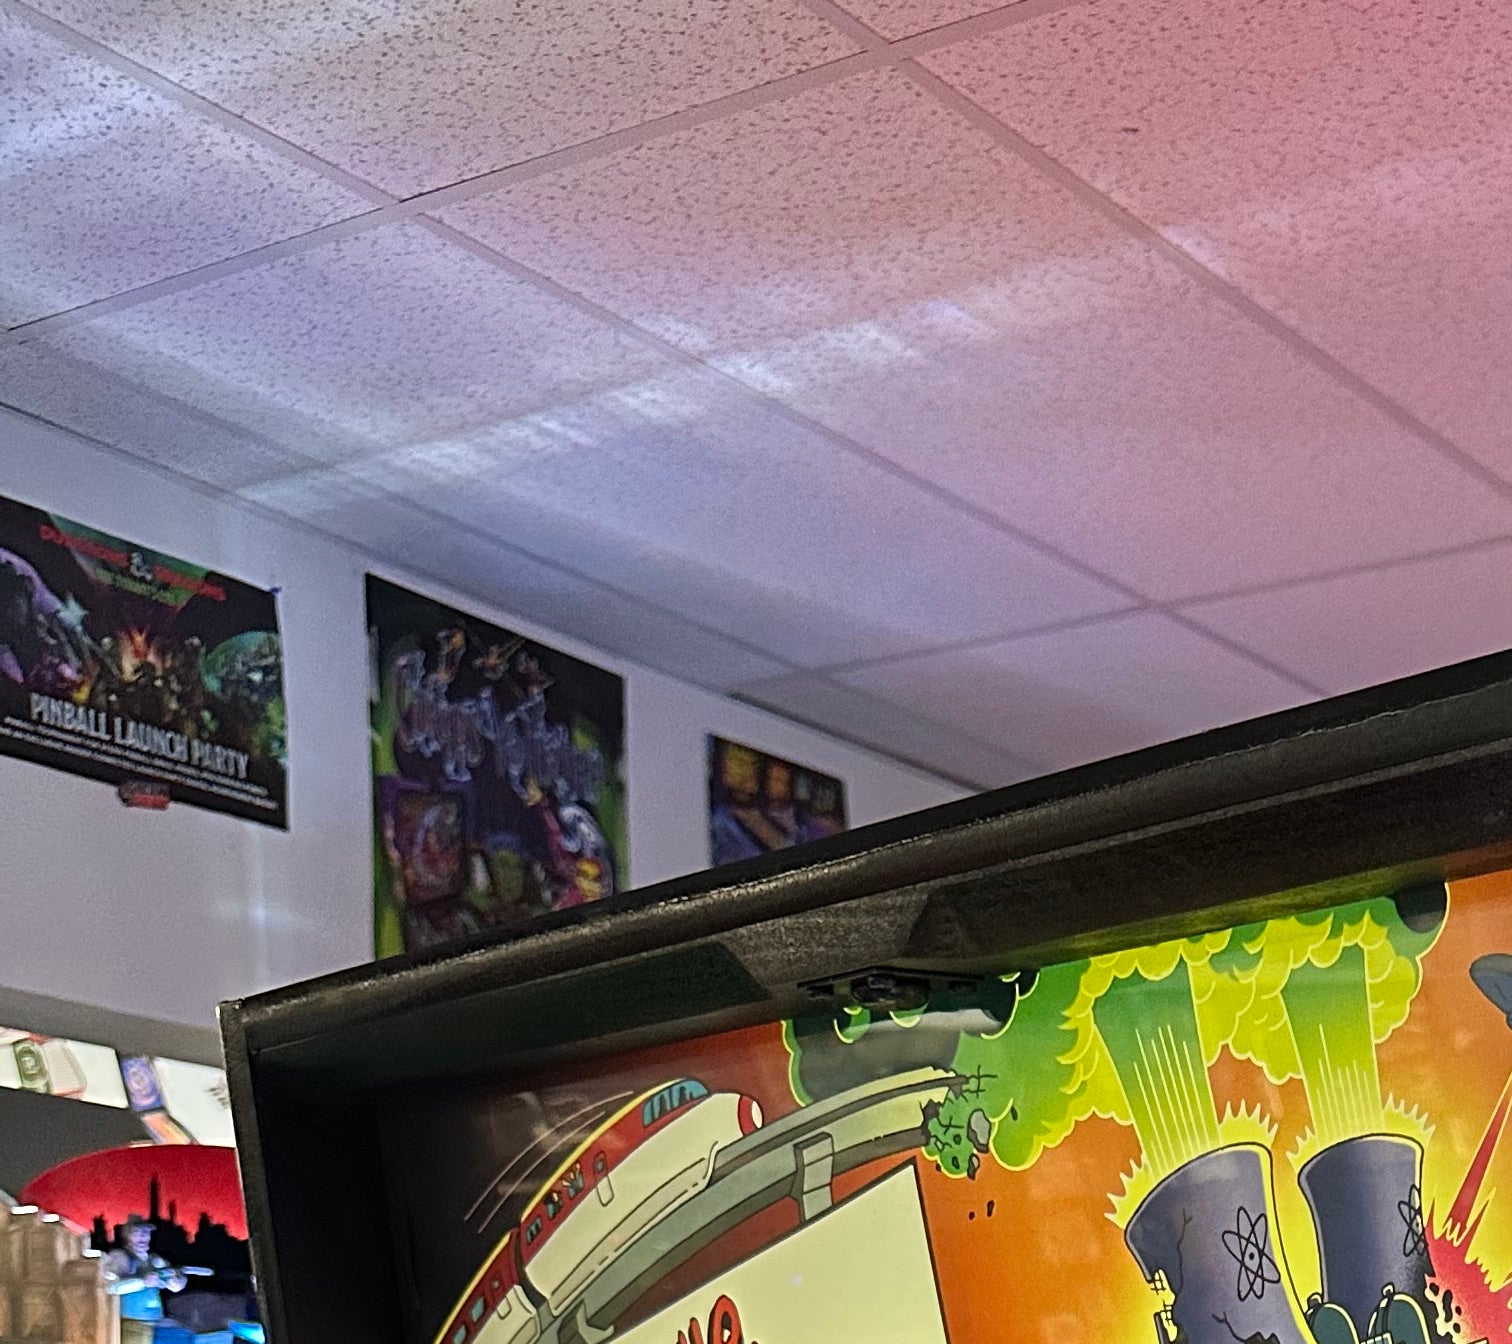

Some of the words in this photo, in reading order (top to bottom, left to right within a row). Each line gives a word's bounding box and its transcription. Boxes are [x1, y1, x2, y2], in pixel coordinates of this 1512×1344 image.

[29, 691, 112, 741] PINBALL
[113, 716, 190, 763] LAUNCH
[190, 737, 250, 779] PARTY
